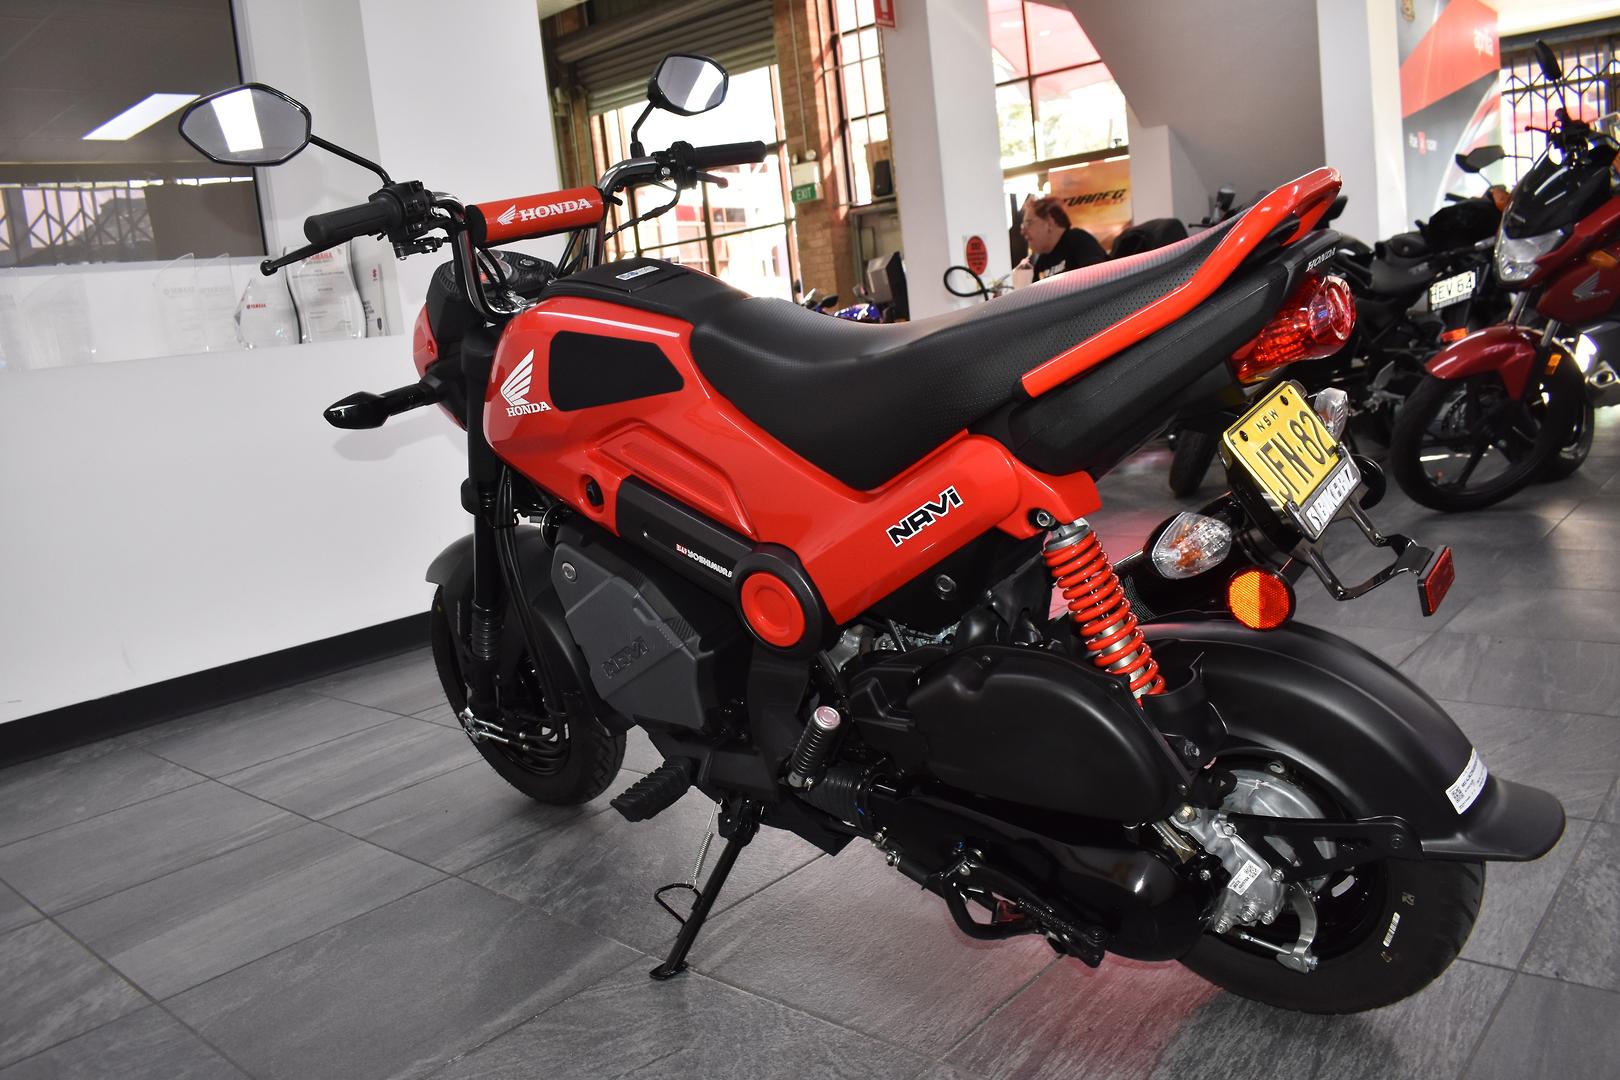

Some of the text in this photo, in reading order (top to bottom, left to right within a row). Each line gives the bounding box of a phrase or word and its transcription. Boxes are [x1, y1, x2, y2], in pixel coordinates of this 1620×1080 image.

[796, 186, 812, 200] EXIT
[519, 198, 593, 222] HONDA
[1305, 247, 1336, 272] HONDA
[506, 401, 552, 417] HONDA
[1256, 409, 1279, 432] NSW
